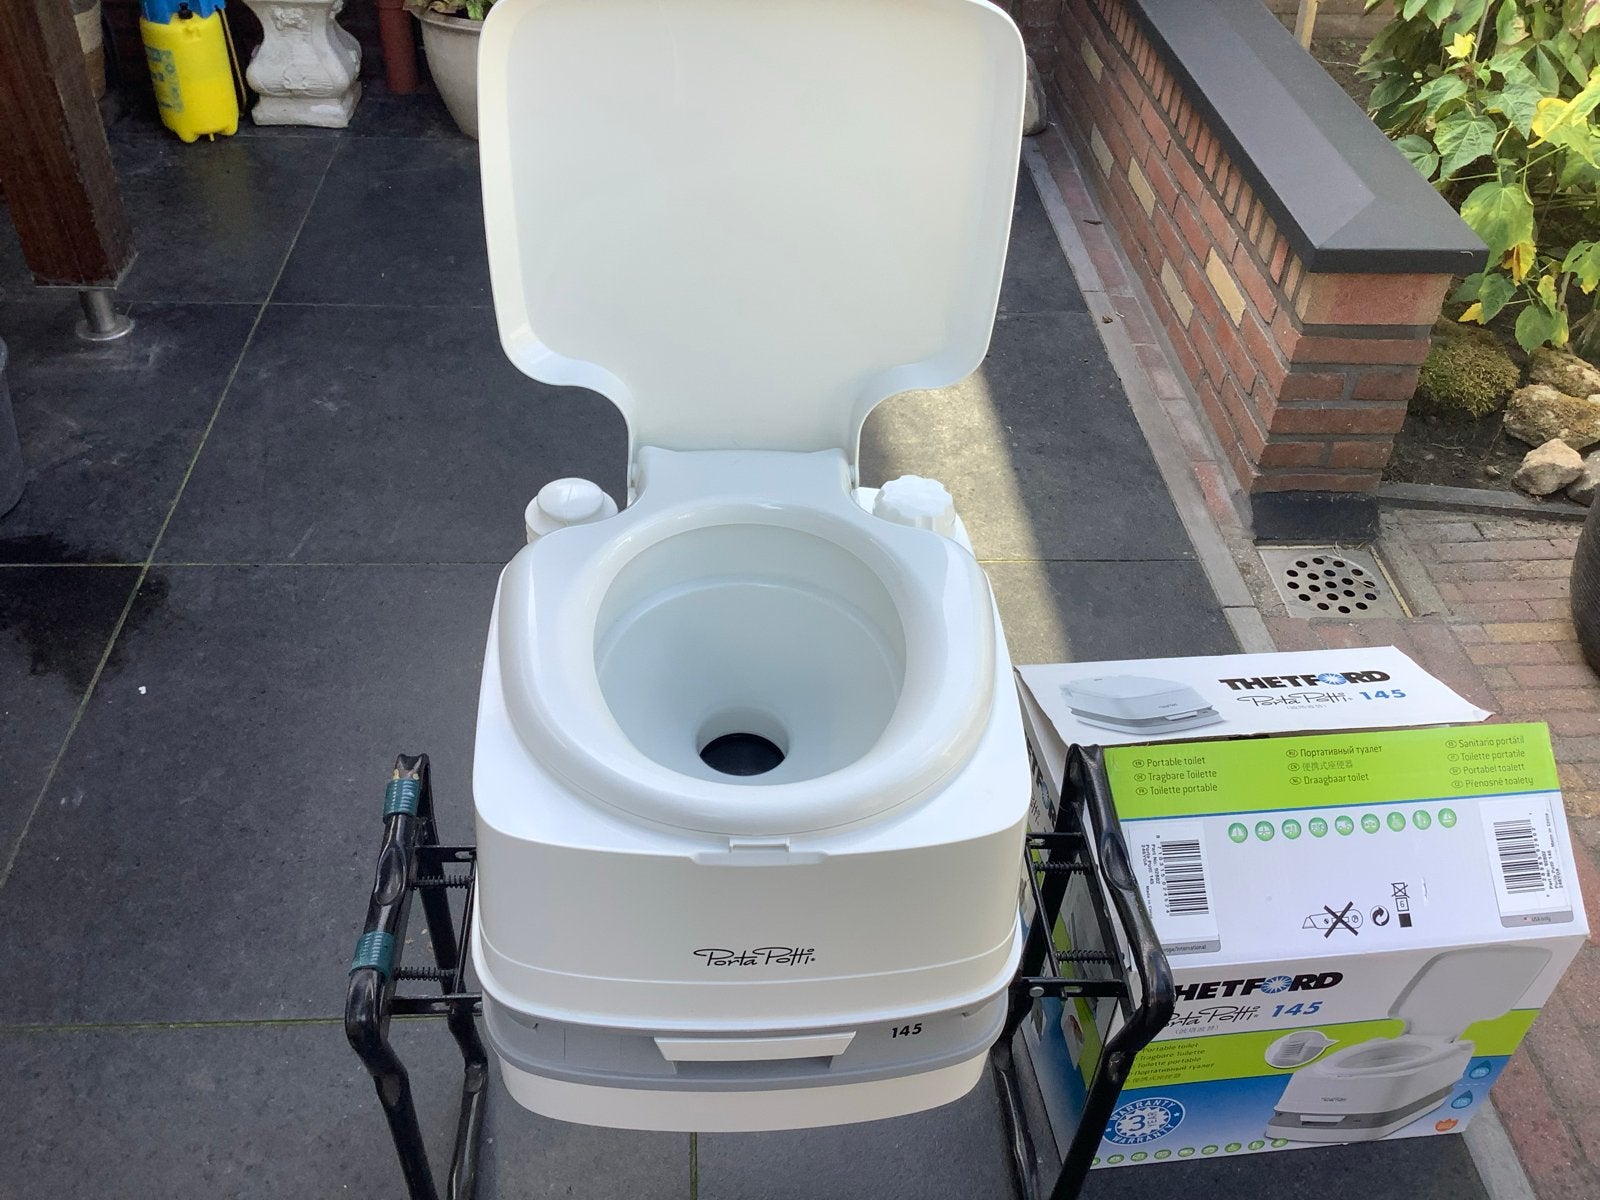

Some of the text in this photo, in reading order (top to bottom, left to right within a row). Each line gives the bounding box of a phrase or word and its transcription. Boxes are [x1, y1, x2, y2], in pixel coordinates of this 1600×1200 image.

[1218, 670, 1391, 691] THETFORD
[1237, 695, 1301, 706] Porta
[1359, 689, 1407, 700] 145
[1458, 738, 1494, 748] Sanitario
[1496, 735, 1525, 747] portátil
[1300, 746, 1355, 758] Портативный
[1356, 745, 1382, 755] туалет
[1461, 752, 1490, 761] Toilette
[1491, 749, 1525, 761] portatile
[1147, 757, 1182, 767] Portable
[1184, 756, 1206, 765] toilet
[1463, 765, 1497, 775] Portabel
[1498, 763, 1526, 772] toalett
[1148, 772, 1185, 783] Tragbare
[1186, 770, 1217, 779] Toilette
[1304, 775, 1347, 786] Draagbaar
[1348, 773, 1369, 782] toilet
[1505, 776, 1534, 786] toalety
[1150, 786, 1181, 795] Toilette
[1182, 783, 1218, 796] portable
[693, 946, 814, 966] Porta Potti
[1175, 971, 1344, 1001] HETFORD
[1199, 1005, 1261, 1023] Potti
[1271, 1001, 1323, 1017] 145
[892, 1023, 922, 1038] 145
[1142, 1045, 1176, 1053] Portable
[1128, 1114, 1146, 1132] 3
